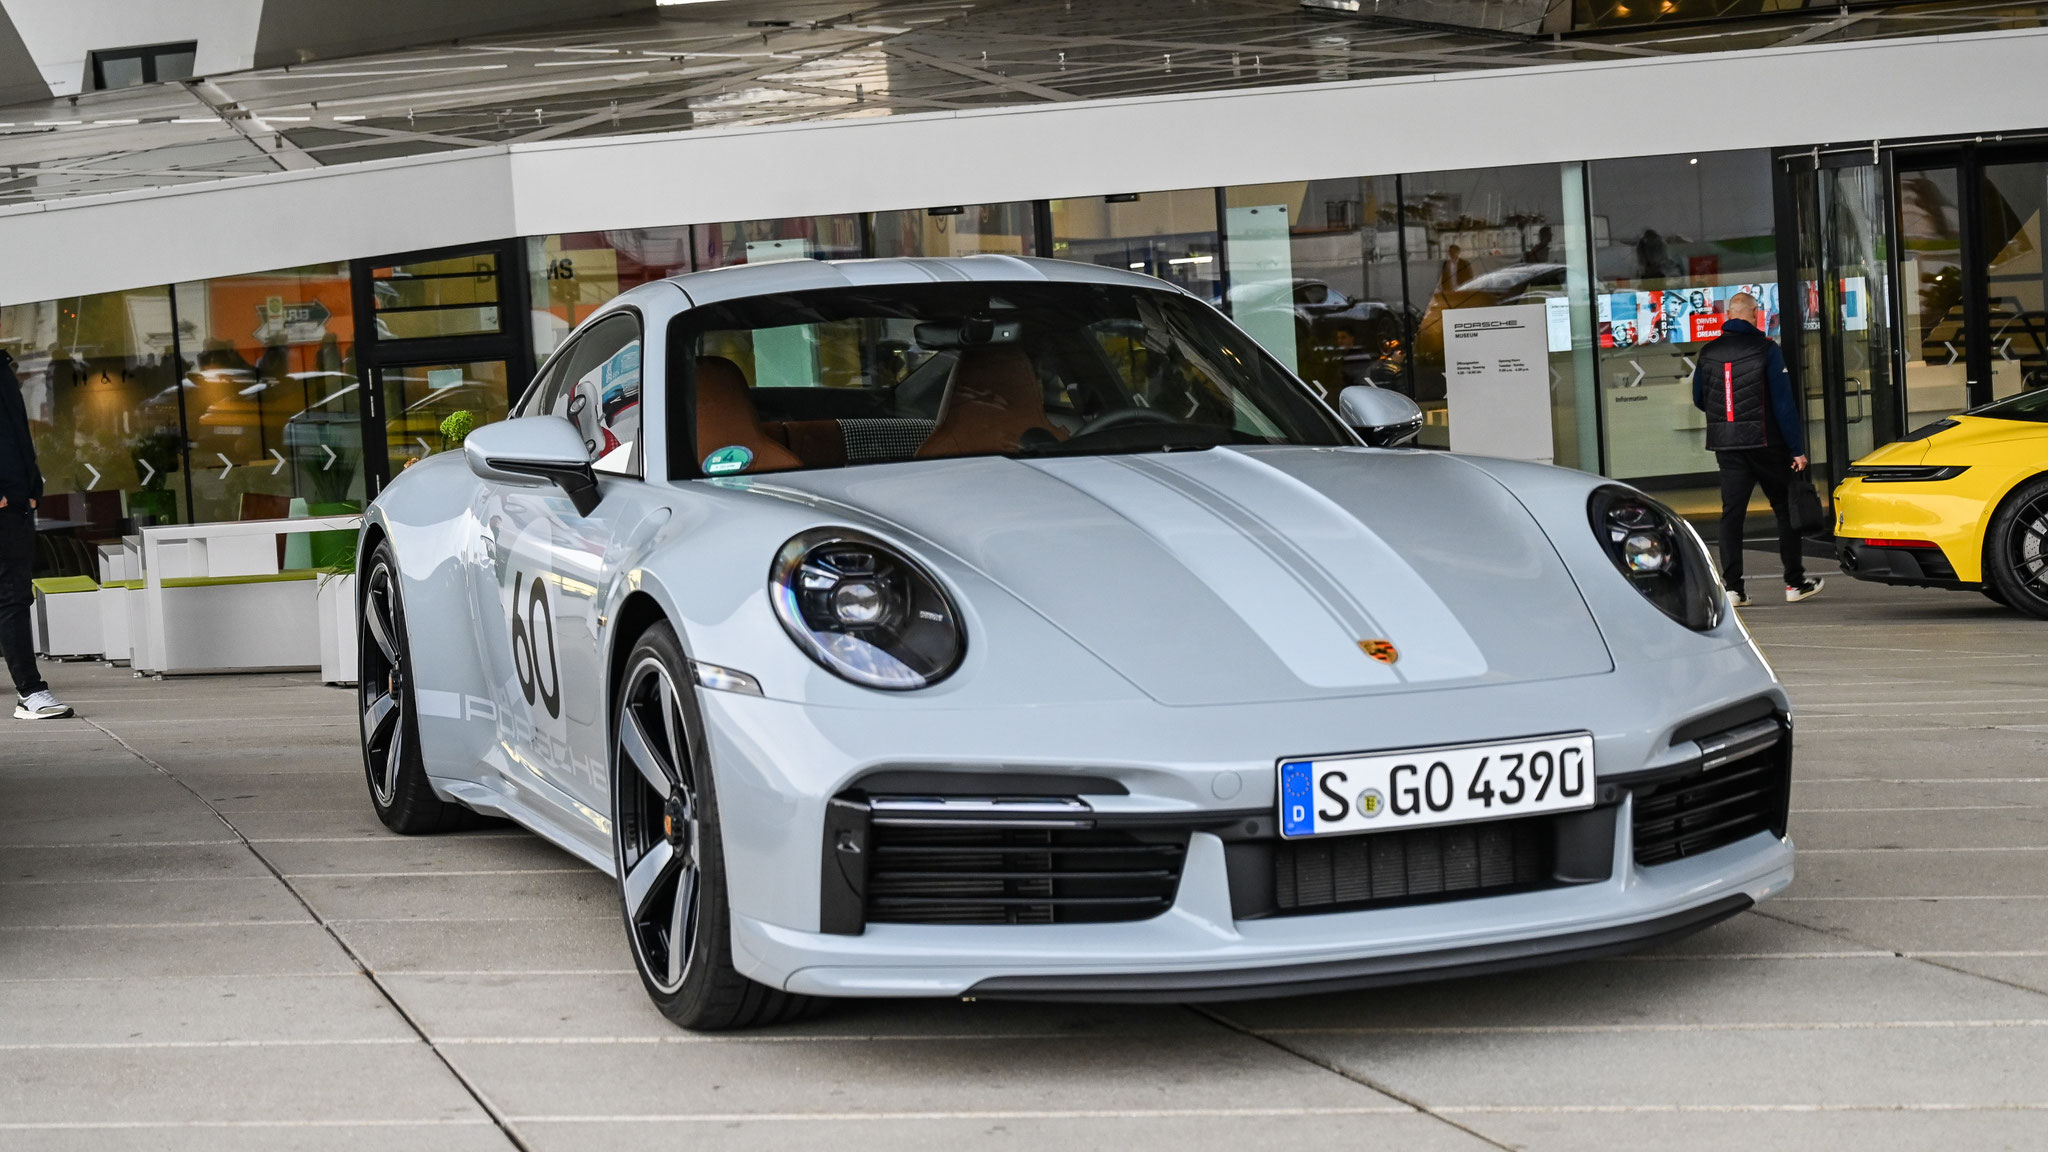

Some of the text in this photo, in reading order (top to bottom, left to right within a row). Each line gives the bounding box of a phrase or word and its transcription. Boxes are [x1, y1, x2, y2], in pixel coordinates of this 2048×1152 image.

[1454, 319, 1517, 329] PORSCHE
[1660, 295, 1668, 338] FERRY
[1697, 330, 1722, 338] DREAMS
[722, 450, 734, 462] 4
[512, 571, 560, 720] 60
[465, 694, 607, 790] PORSCHE
[1318, 747, 1584, 822] S GO 4390
[1292, 805, 1305, 822] D
